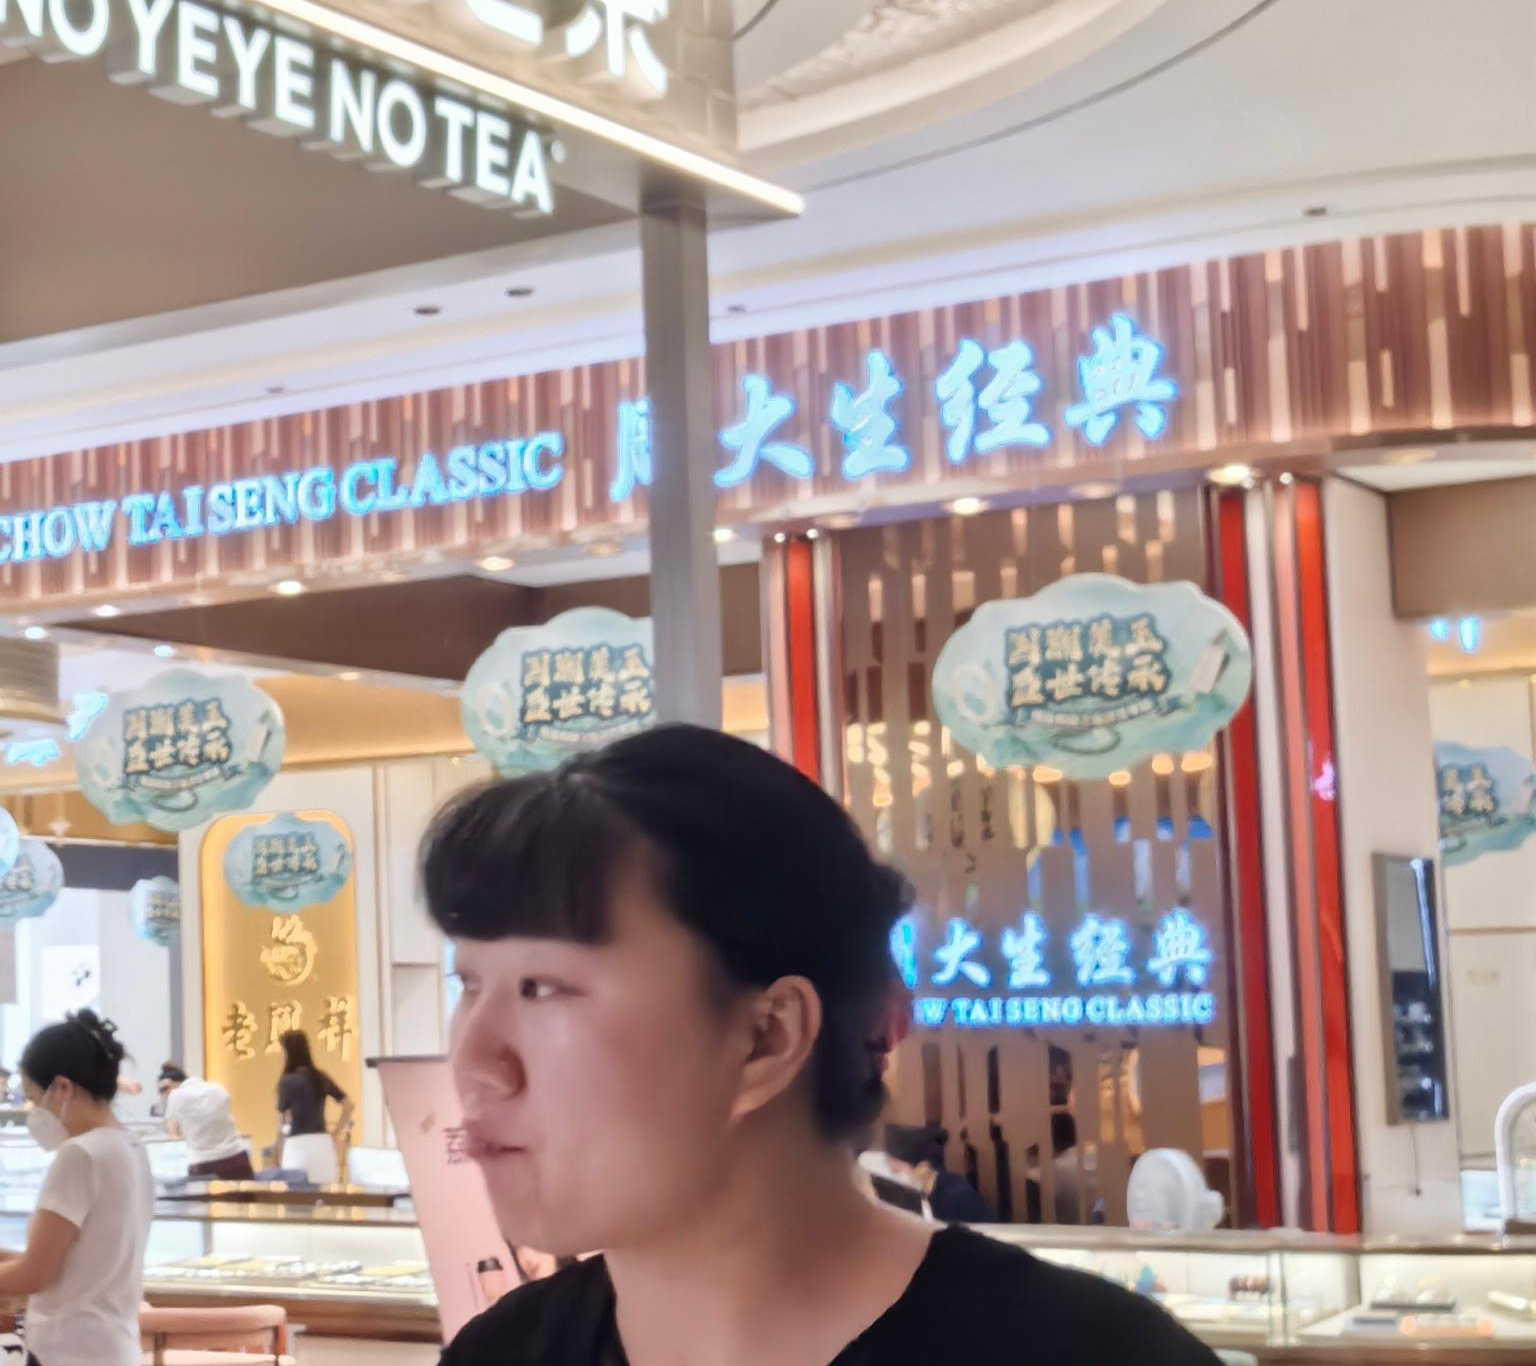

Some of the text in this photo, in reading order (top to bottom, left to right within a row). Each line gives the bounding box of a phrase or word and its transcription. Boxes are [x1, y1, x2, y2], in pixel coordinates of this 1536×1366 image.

[330, 59, 426, 169] NO
[435, 96, 553, 215] TEA
[339, 433, 562, 516] CLASSIC
[1085, 993, 1214, 1024] CLASSIC
